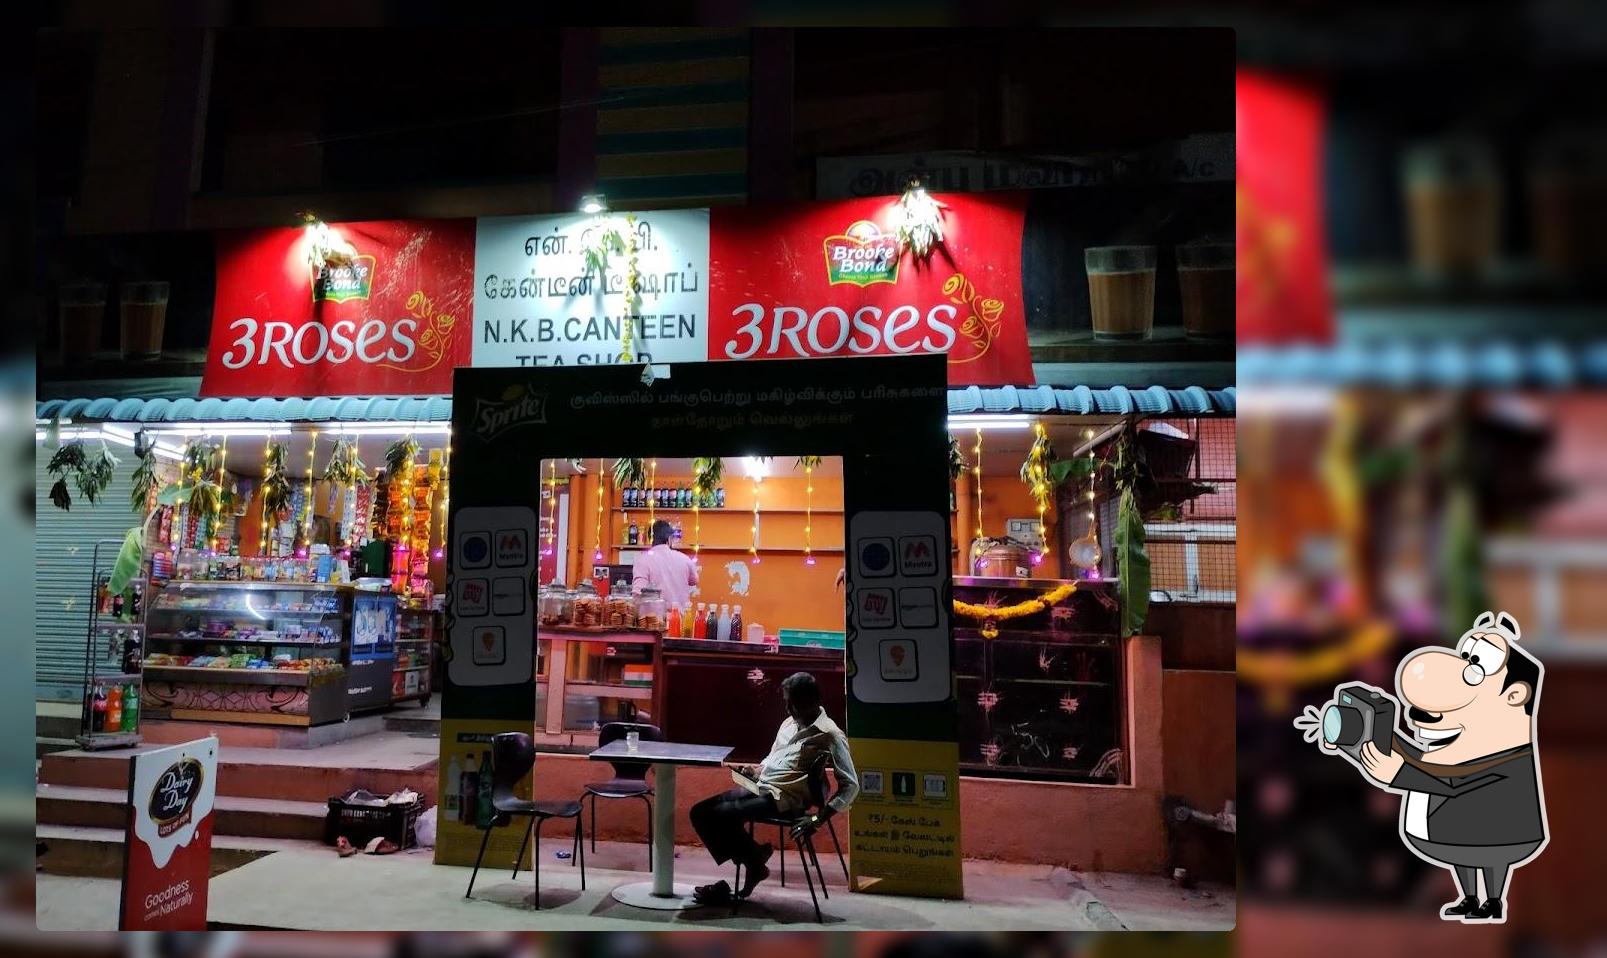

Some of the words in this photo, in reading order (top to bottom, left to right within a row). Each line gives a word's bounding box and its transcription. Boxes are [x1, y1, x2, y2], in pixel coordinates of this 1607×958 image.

[832, 244, 895, 260] Brooke
[840, 258, 887, 273] Bond
[476, 394, 540, 434] Sprite
[160, 771, 194, 794] Dairy
[162, 789, 189, 812] Day
[144, 879, 190, 910] Goodness
[159, 891, 194, 918] Naturally
